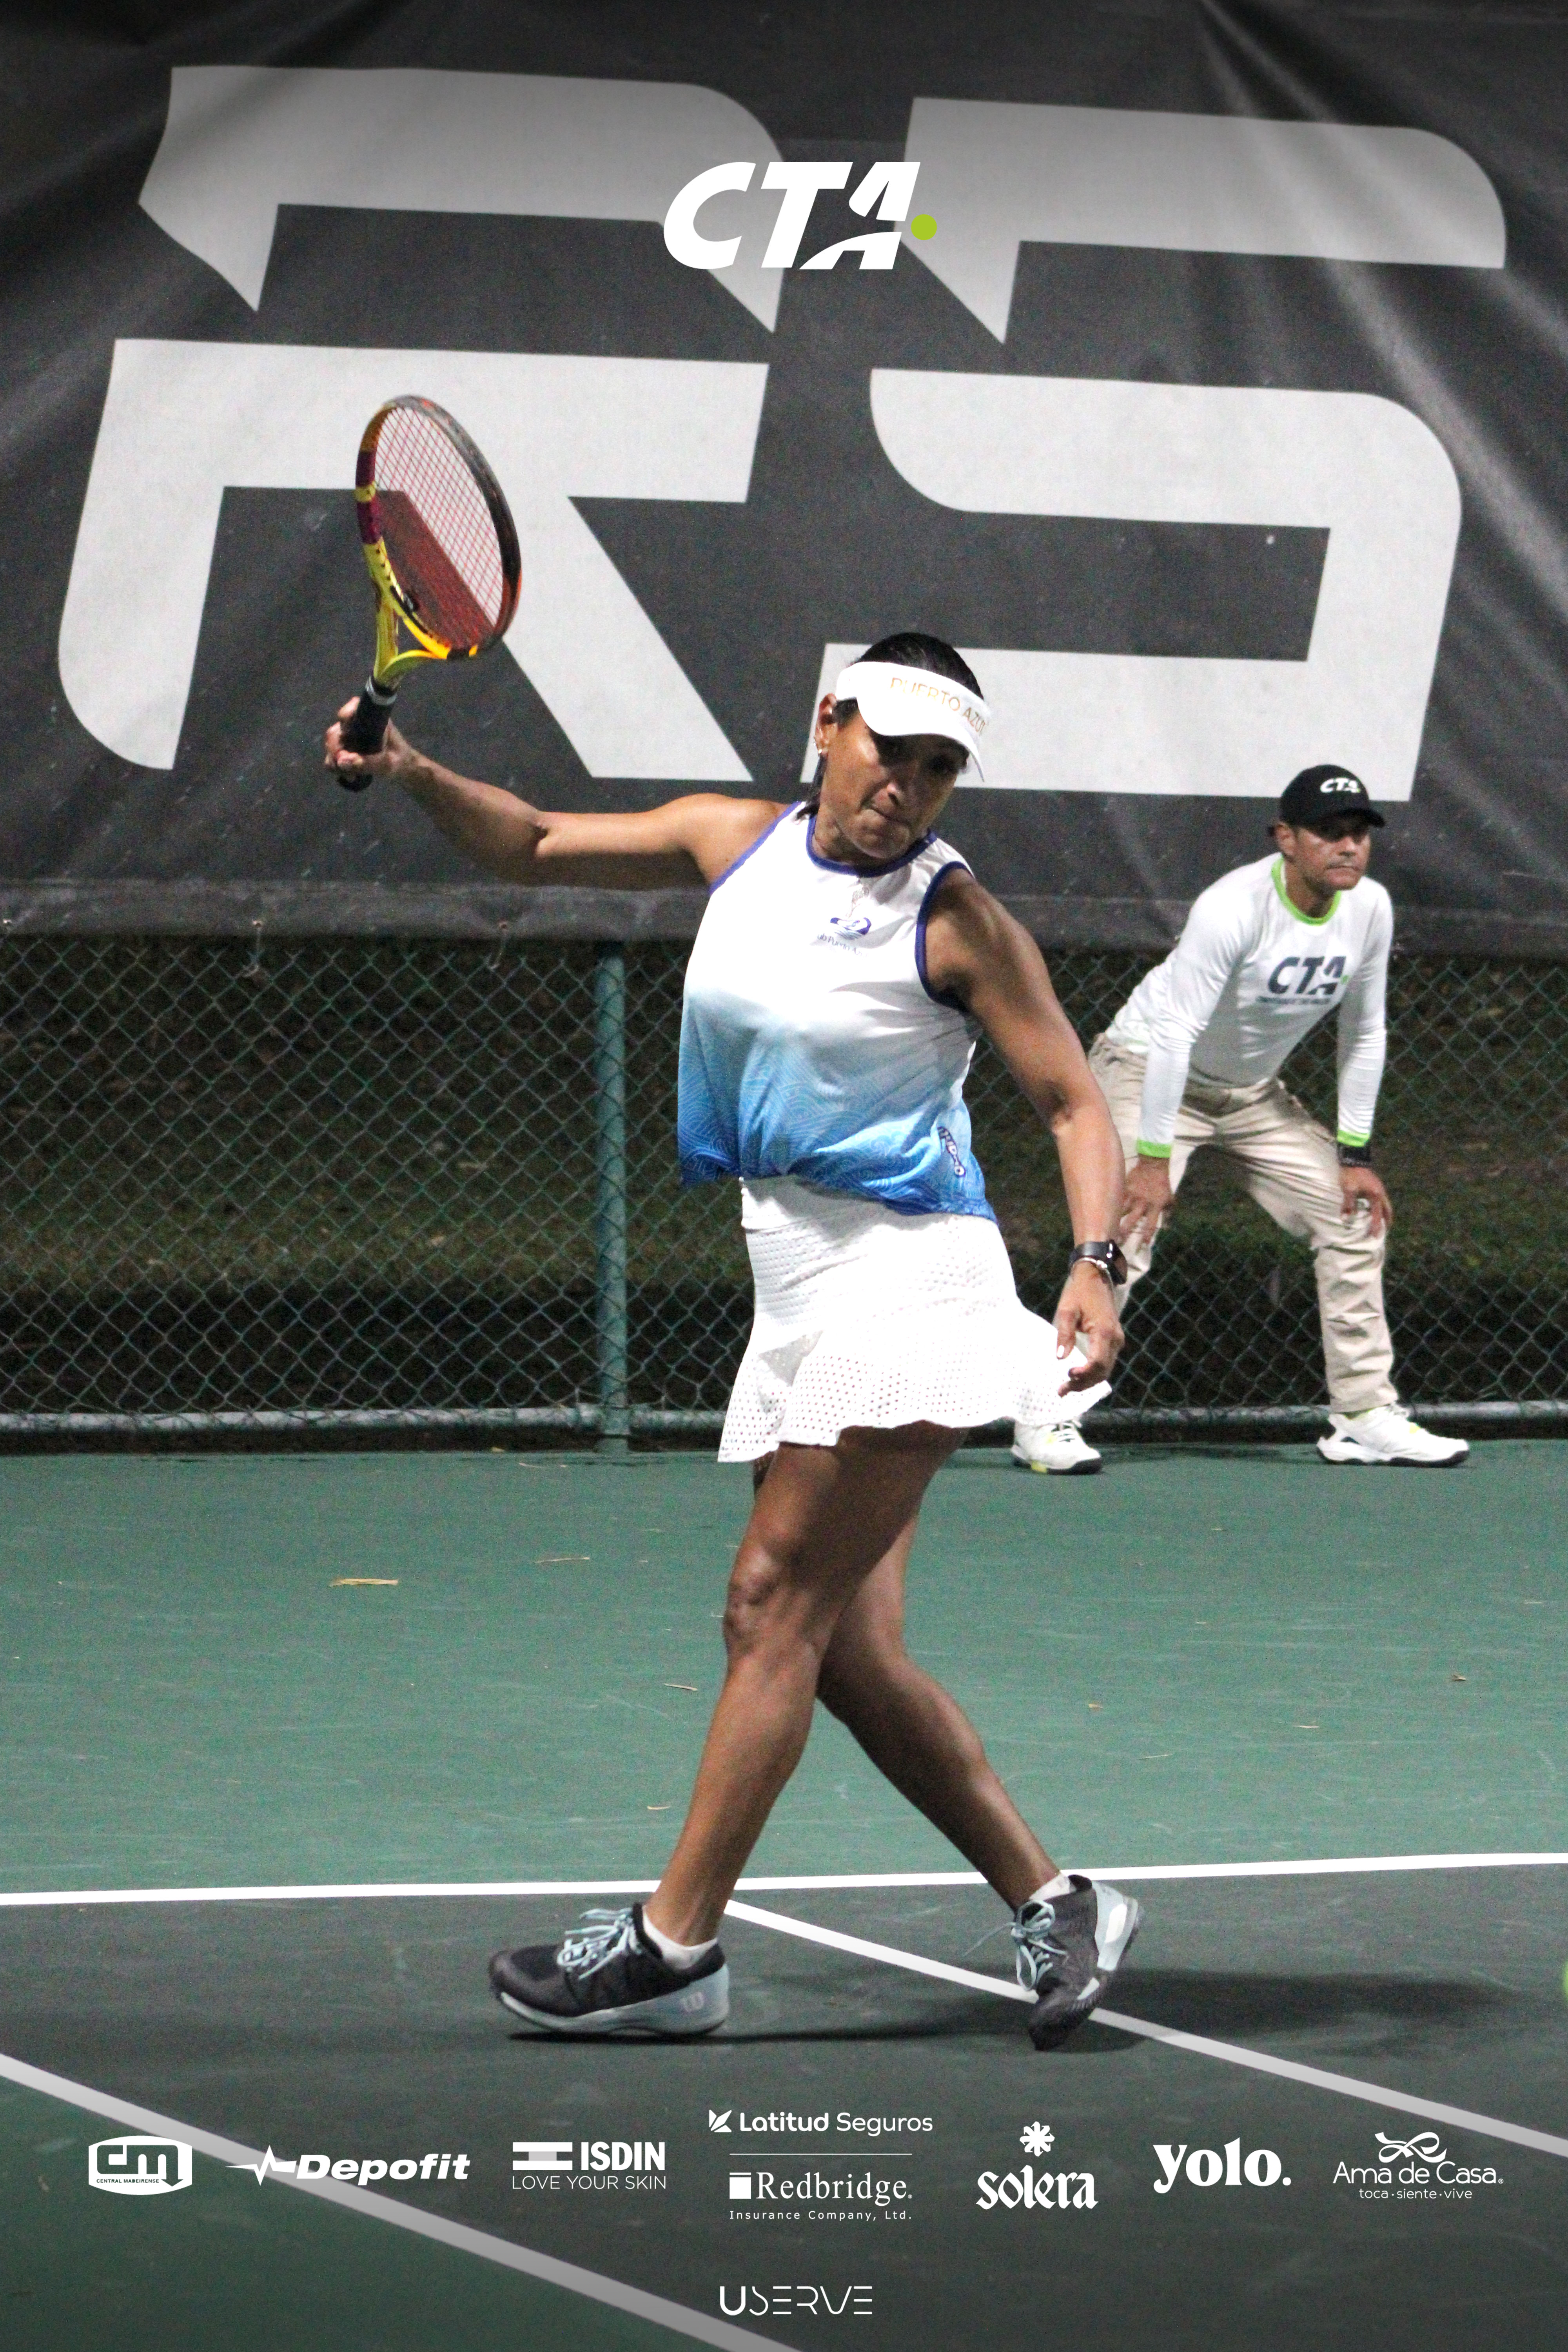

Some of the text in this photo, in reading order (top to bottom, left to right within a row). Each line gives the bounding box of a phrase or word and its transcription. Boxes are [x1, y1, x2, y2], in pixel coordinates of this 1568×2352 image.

[890, 677, 986, 733] PUERTO AZU
[1320, 777, 1358, 793] CTA
[1268, 955, 1347, 995] CTA
